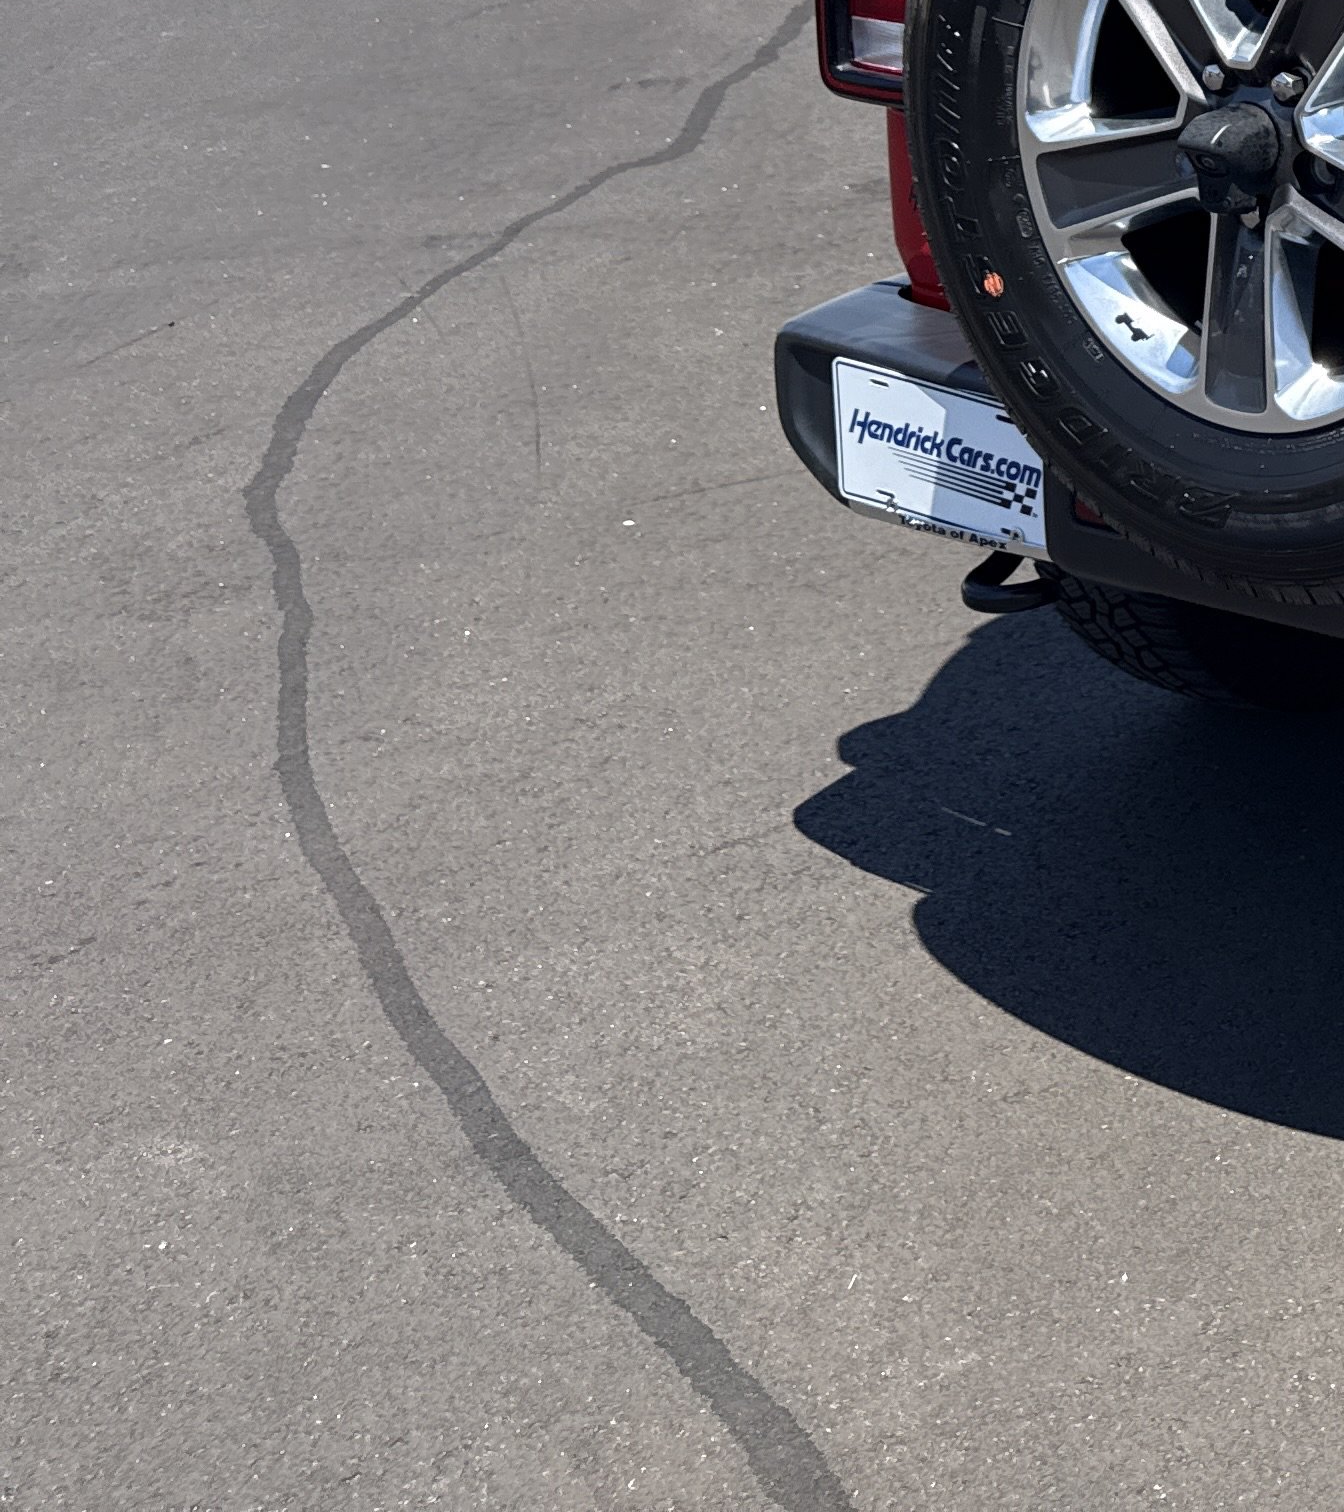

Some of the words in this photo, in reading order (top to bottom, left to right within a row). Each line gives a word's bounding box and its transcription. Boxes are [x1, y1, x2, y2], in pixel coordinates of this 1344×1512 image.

[899, 514, 946, 536] Toyota
[950, 530, 964, 540] of
[968, 533, 1007, 550] Apex
